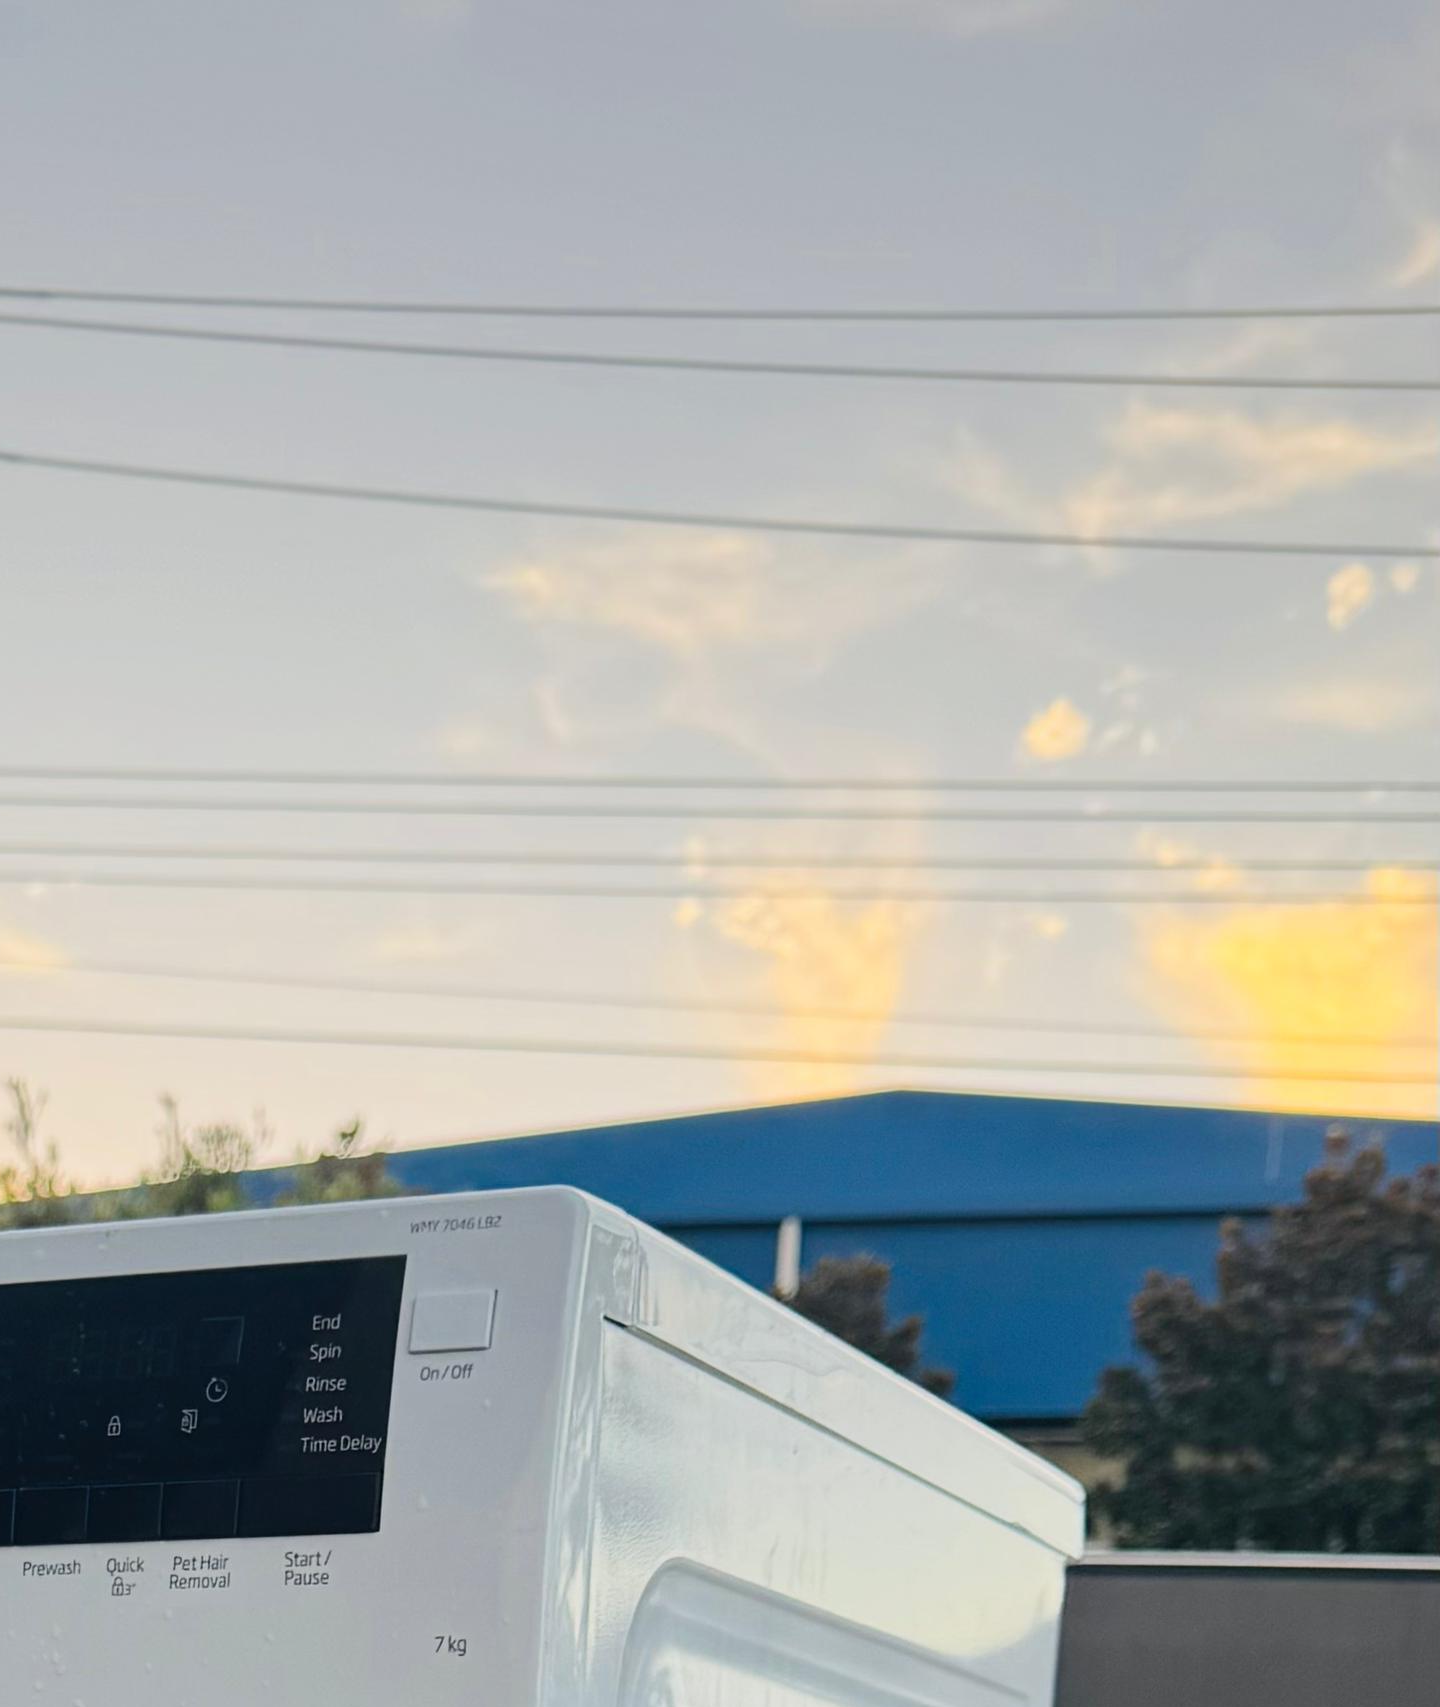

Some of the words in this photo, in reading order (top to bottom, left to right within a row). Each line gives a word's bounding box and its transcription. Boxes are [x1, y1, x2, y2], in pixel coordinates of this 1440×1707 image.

[312, 1313, 341, 1331] End
[309, 1343, 342, 1362] Spin
[305, 1375, 347, 1393] Rinse
[303, 1406, 343, 1424] Wash
[300, 1436, 337, 1453] Time
[339, 1433, 382, 1454] Delay
[22, 1558, 81, 1577] Prewash
[106, 1556, 144, 1577] Quick
[172, 1556, 196, 1572] Pet
[199, 1554, 228, 1570] Hair
[284, 1552, 320, 1569] Start
[169, 1572, 231, 1591] Removal
[284, 1569, 330, 1587] Pause
[434, 1636, 445, 1653] 7
[447, 1635, 468, 1657] kg
